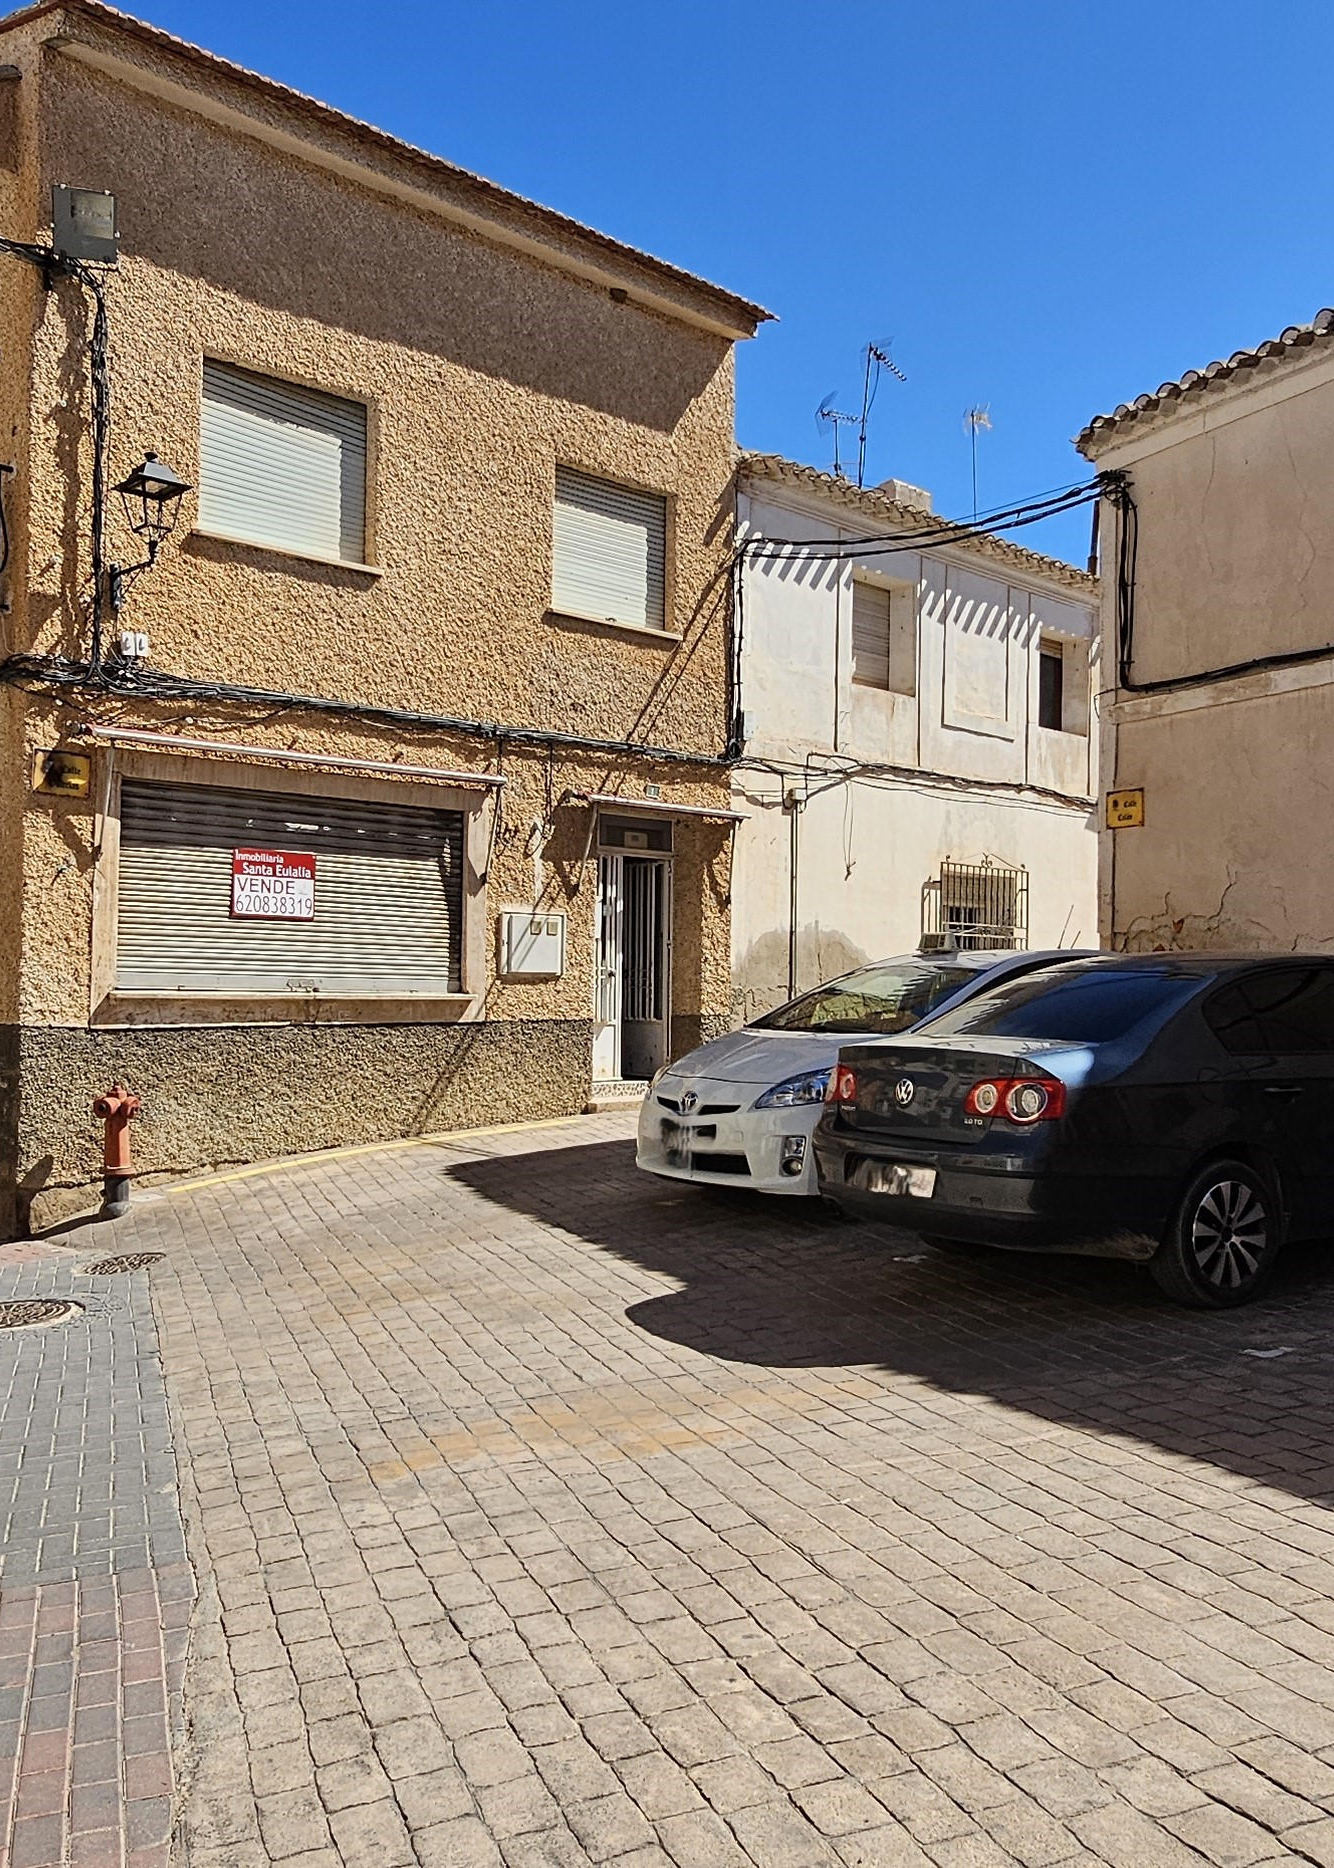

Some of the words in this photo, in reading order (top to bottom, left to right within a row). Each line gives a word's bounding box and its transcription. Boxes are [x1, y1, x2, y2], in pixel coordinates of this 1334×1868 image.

[234, 849, 284, 864] Inmobiliaria
[243, 862, 273, 876] Santa
[276, 864, 312, 879] Eulalia
[237, 877, 296, 896] VENDE
[235, 894, 313, 916] 620838319
